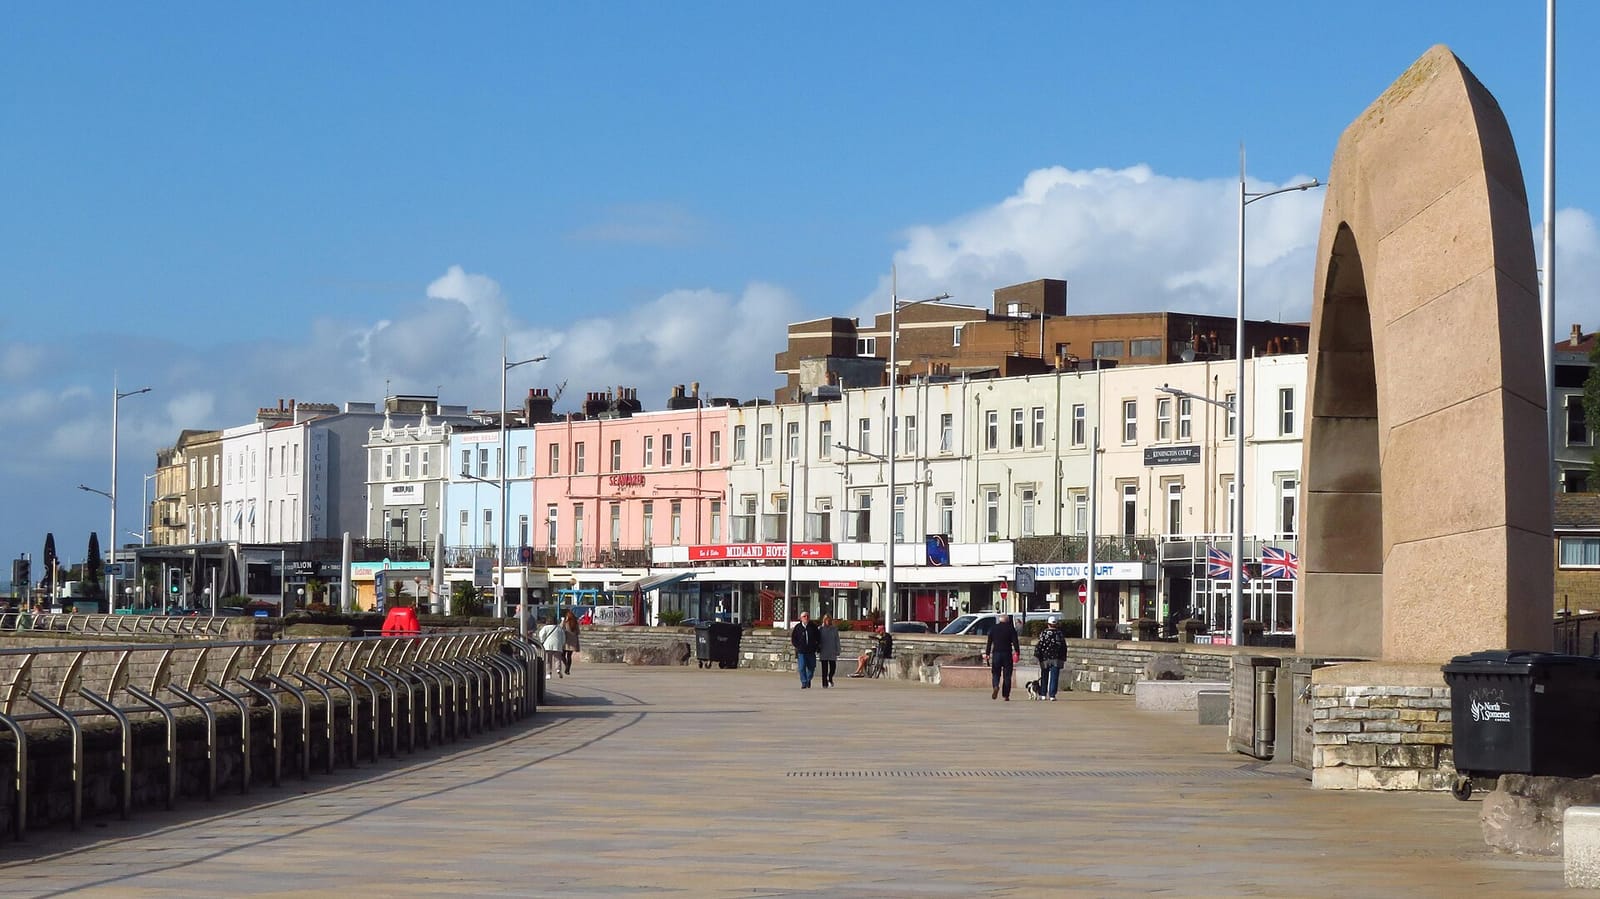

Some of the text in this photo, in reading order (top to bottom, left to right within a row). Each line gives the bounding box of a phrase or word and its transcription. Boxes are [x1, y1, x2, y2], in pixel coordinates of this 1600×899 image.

[726, 546, 788, 557] MIDLAND HOTE
[1035, 566, 1080, 577] NSINGTON
[1083, 566, 1114, 576] CURT
[1484, 702, 1500, 711] North
[1484, 711, 1510, 720] Somerset
